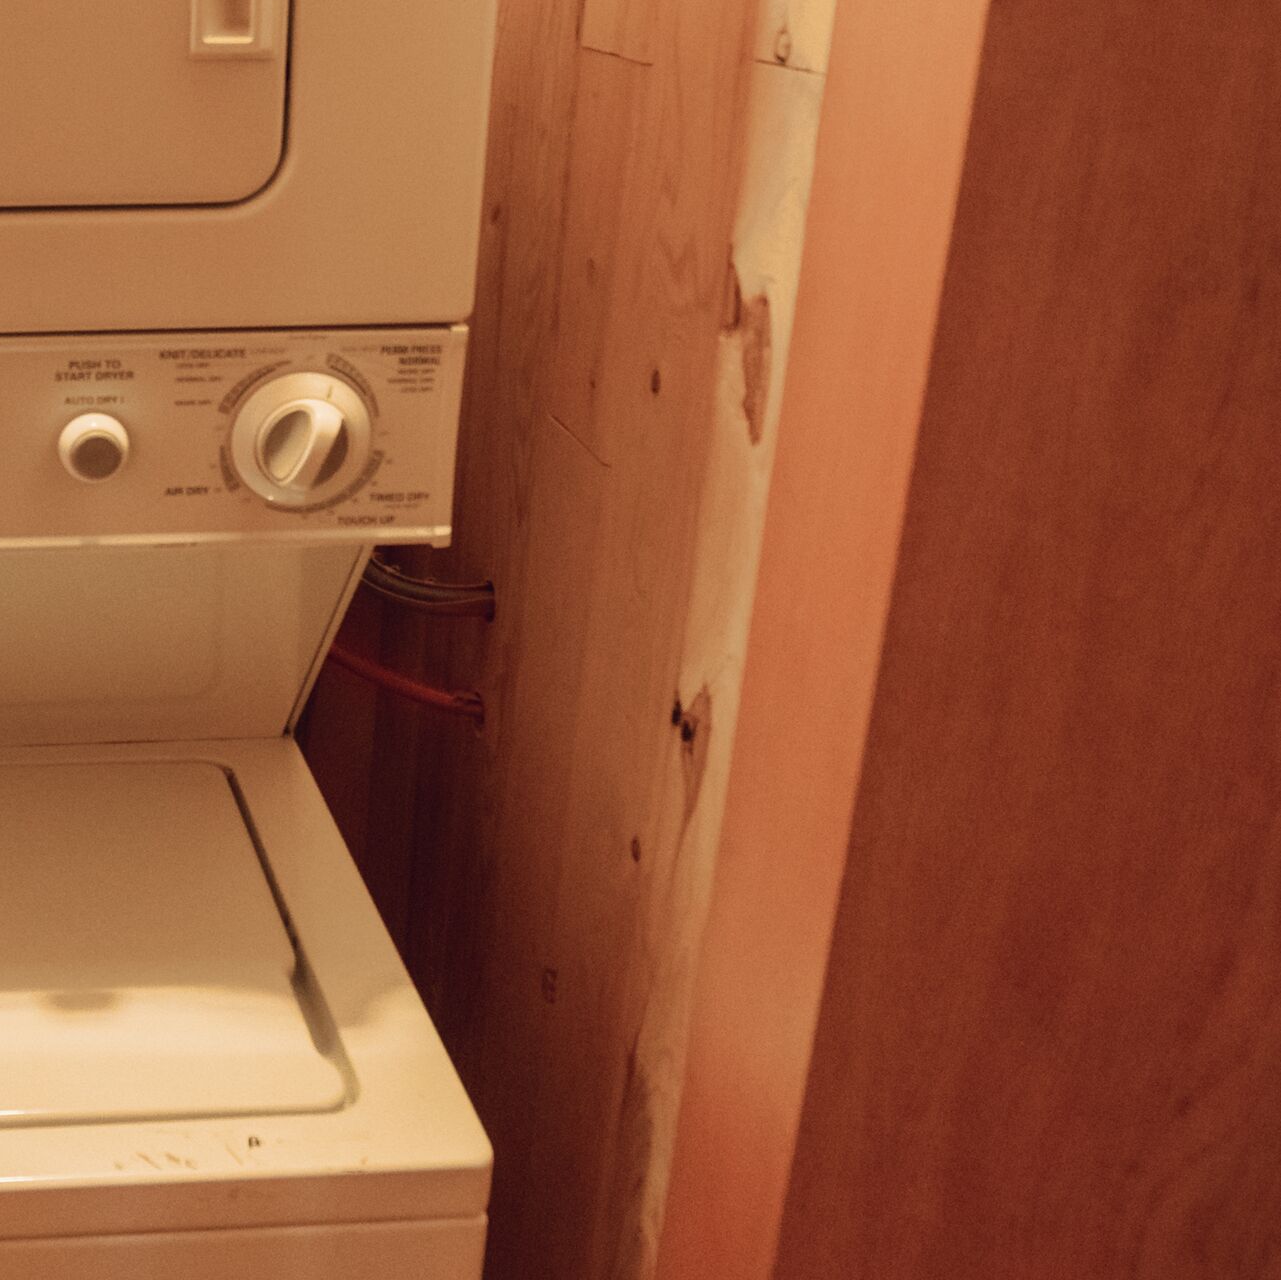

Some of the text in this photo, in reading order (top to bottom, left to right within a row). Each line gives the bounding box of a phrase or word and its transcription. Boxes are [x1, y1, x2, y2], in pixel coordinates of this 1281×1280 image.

[69, 359, 121, 371] PUSH TO
[55, 370, 135, 383] START DRYER
[64, 396, 94, 406] AUTO
[95, 395, 119, 405] DRY
